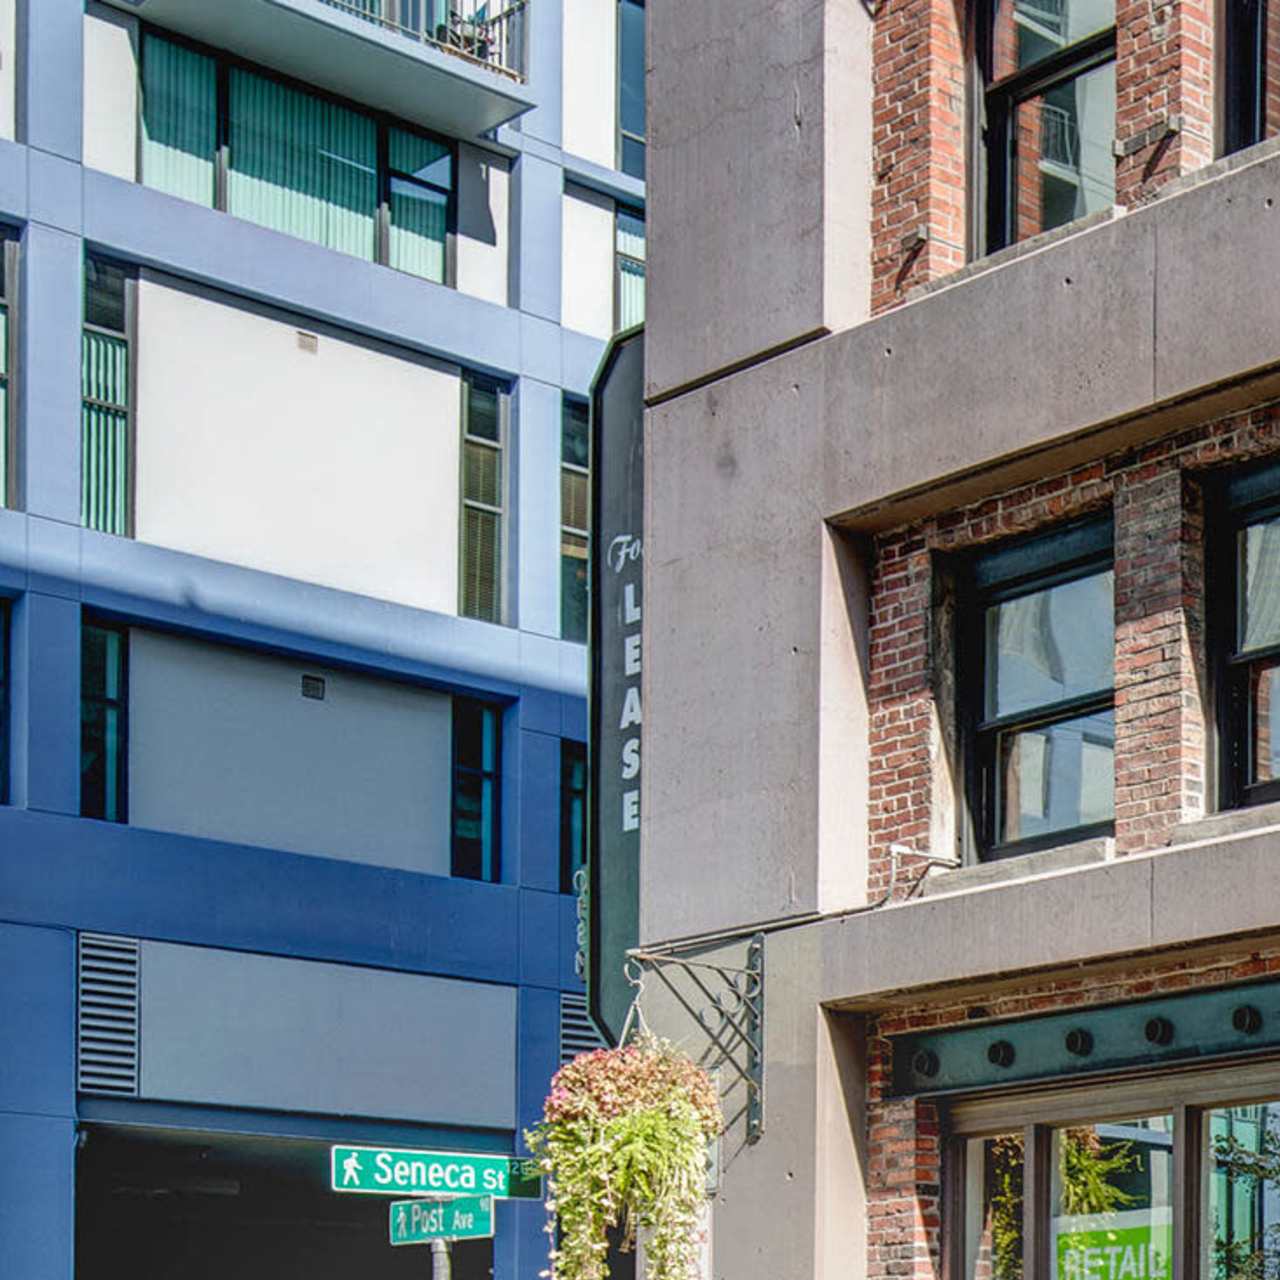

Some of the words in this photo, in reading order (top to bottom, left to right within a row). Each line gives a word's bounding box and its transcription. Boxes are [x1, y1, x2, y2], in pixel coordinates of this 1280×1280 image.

[620, 583, 642, 832] LEASE
[374, 1153, 476, 1189] Seneca
[483, 1168, 506, 1190] St
[411, 1203, 445, 1235] Post
[452, 1210, 474, 1231] Ave
